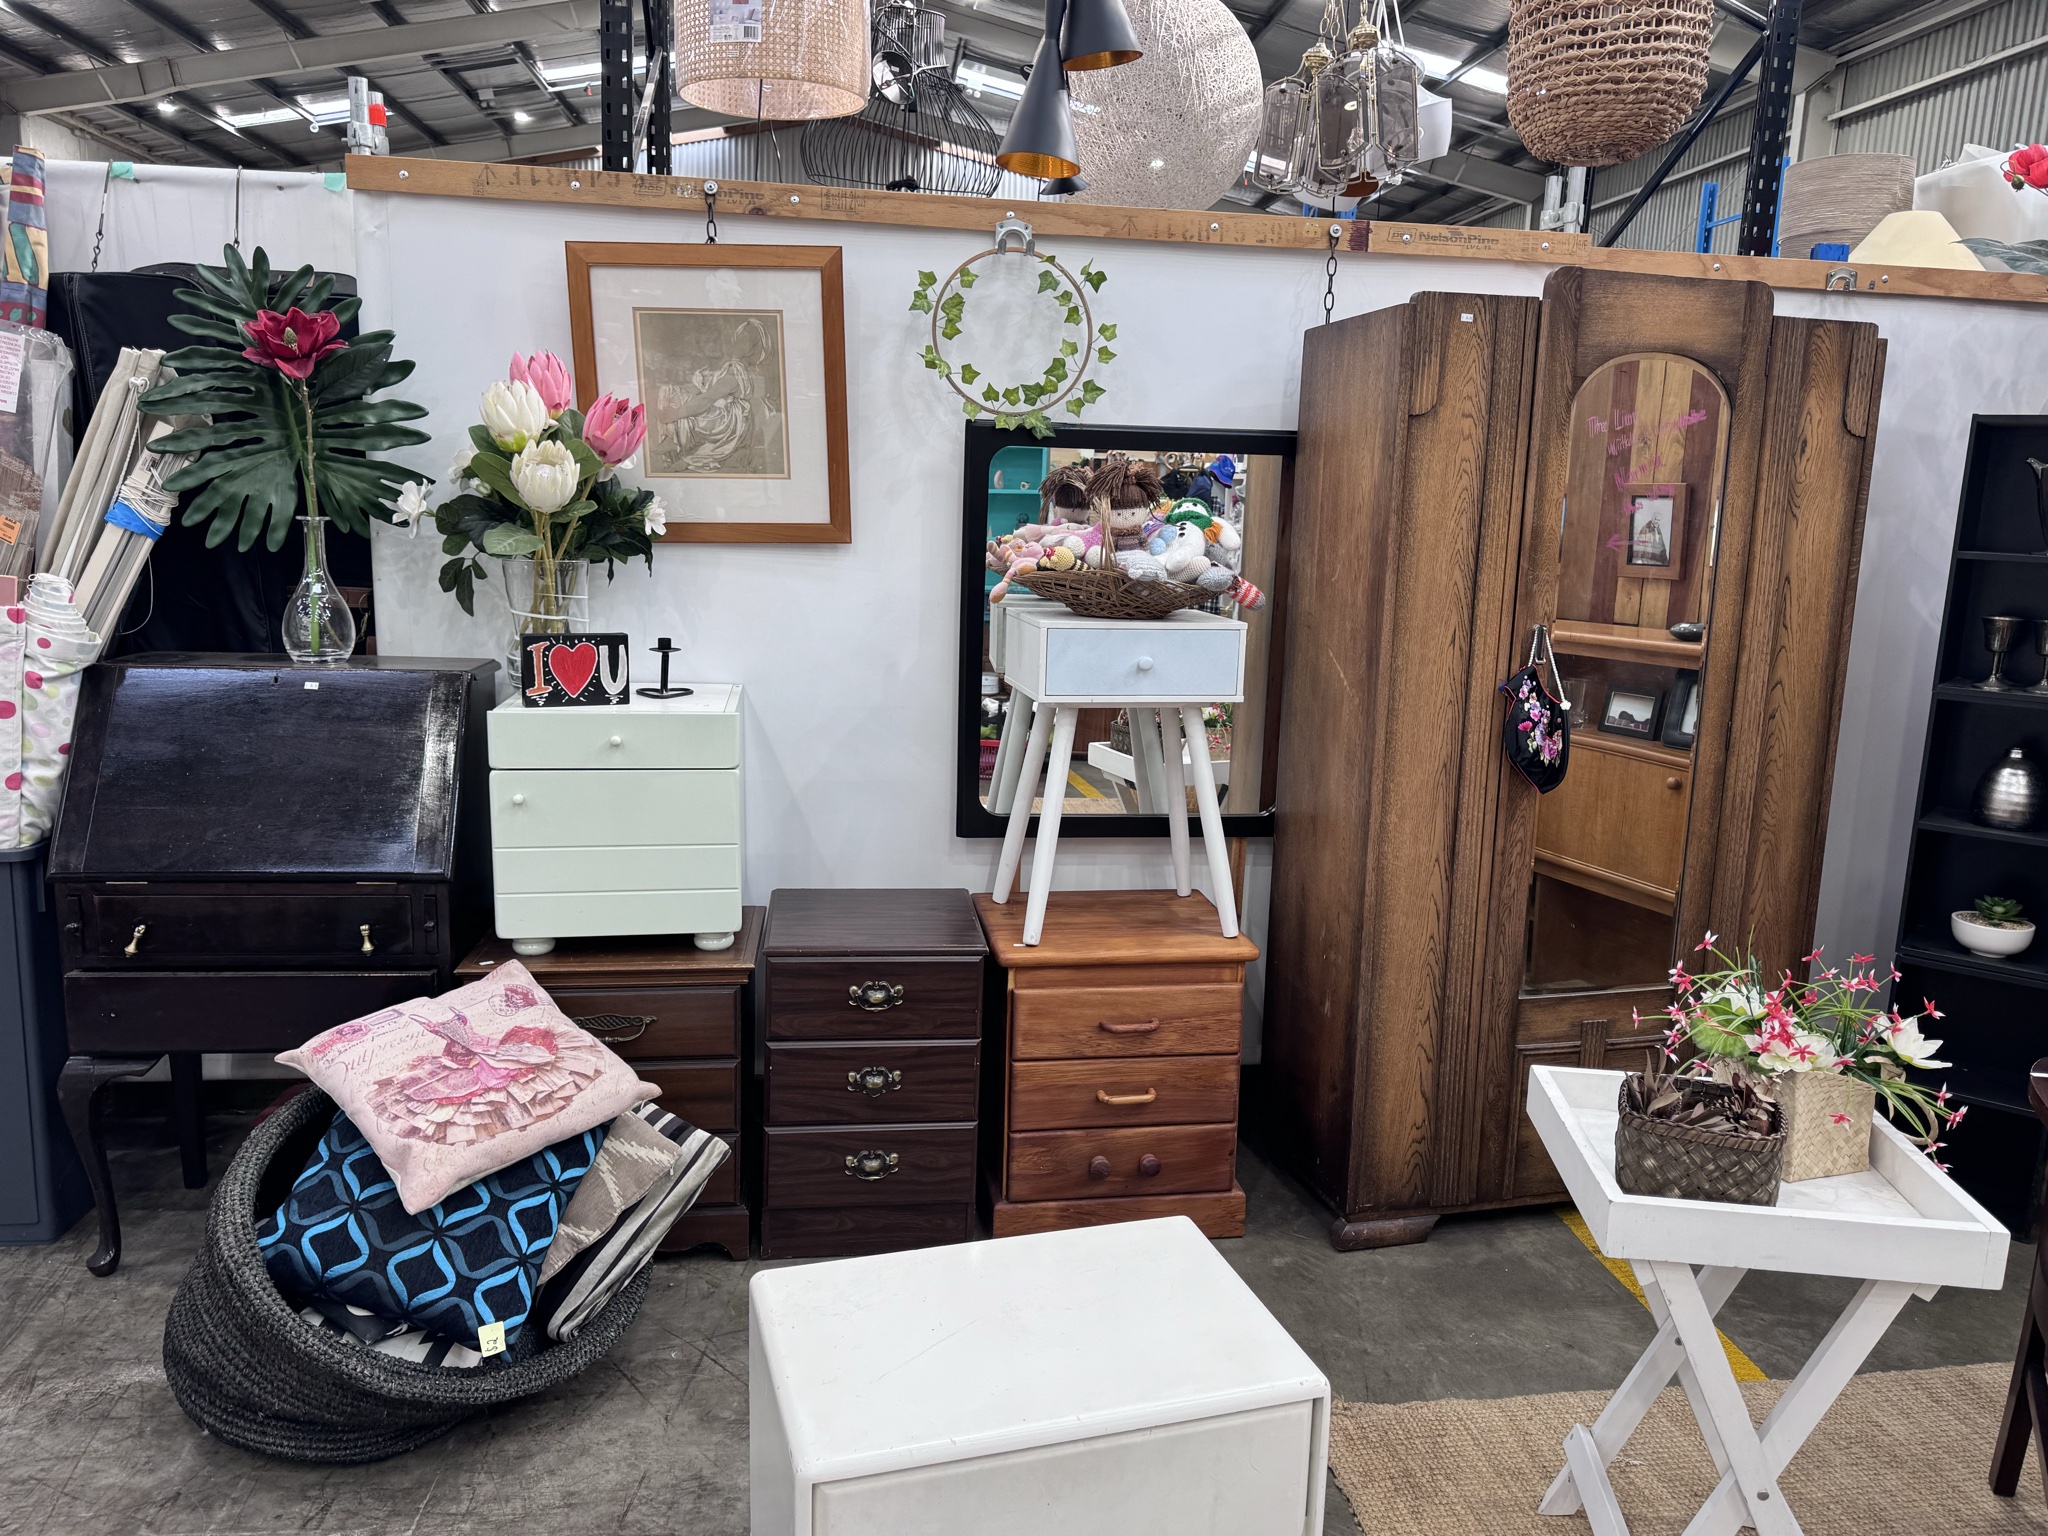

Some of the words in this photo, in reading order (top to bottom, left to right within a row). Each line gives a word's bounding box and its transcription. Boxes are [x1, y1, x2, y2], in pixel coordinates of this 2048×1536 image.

[1418, 230, 1500, 245] NelsonPine
[526, 641, 553, 697] I
[599, 644, 628, 694] U
